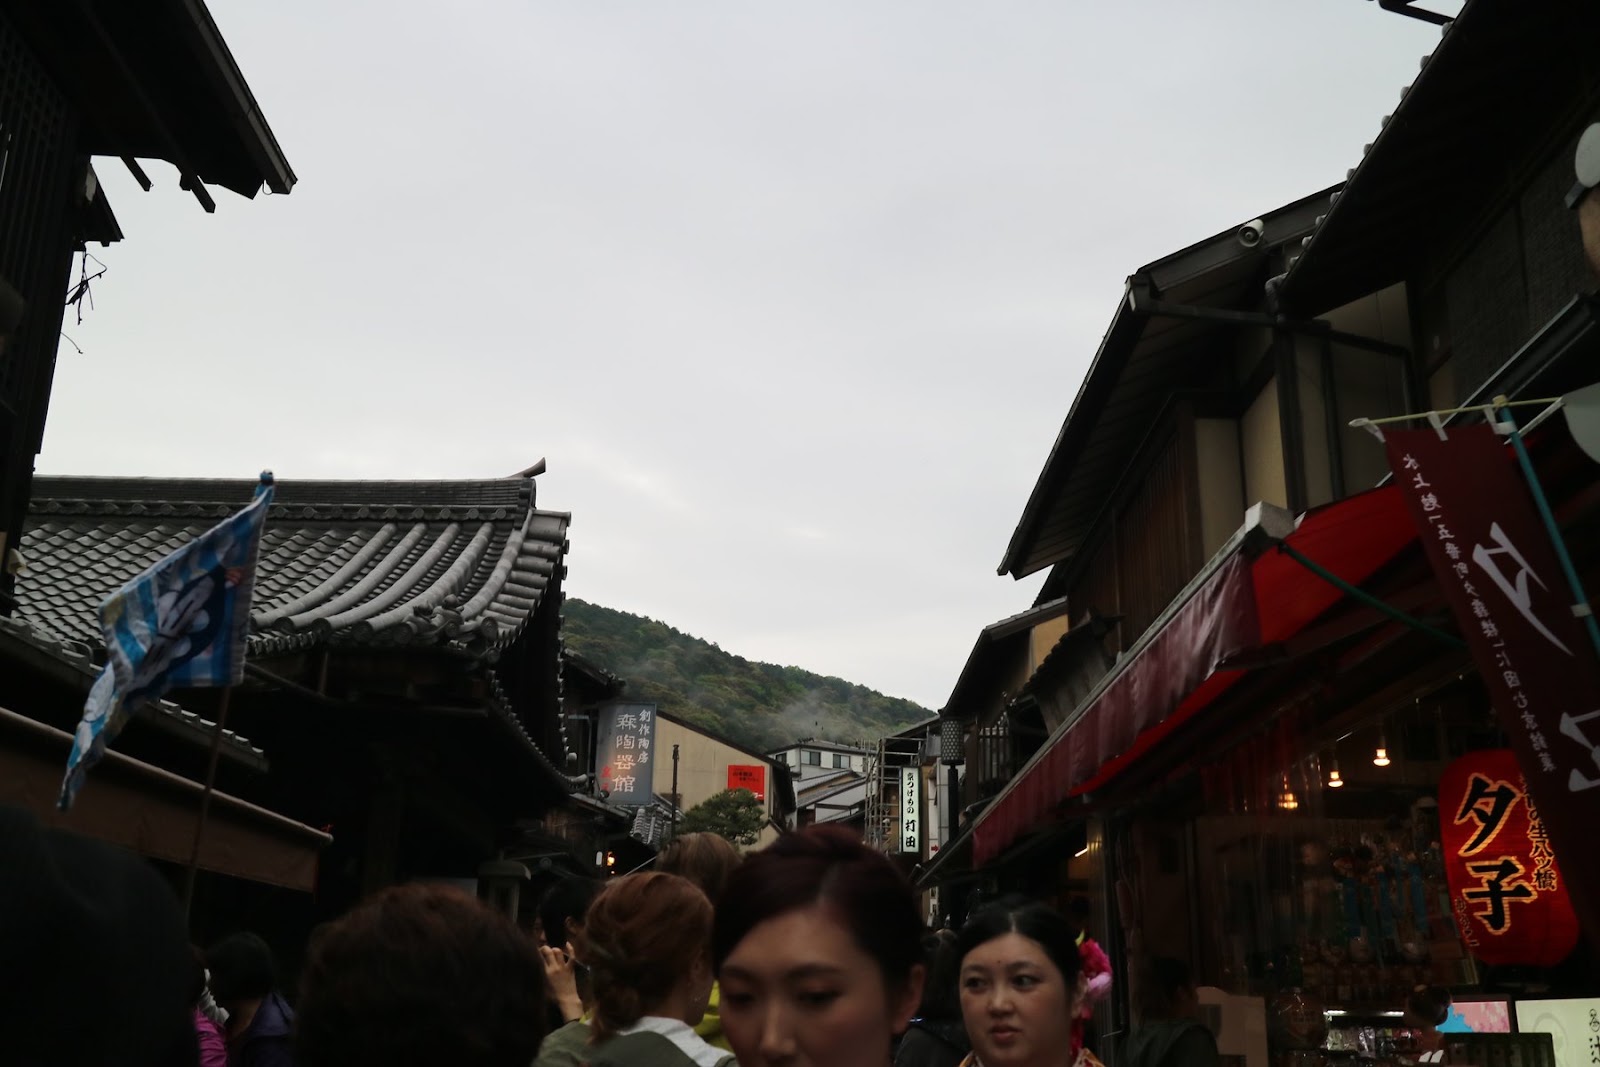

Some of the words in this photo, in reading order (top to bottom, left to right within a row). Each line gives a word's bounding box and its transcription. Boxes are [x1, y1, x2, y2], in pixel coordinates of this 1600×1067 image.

[612, 713, 637, 793] 森陶器館
[637, 708, 652, 764] 創作陶房
[905, 819, 917, 848] 打田
[1453, 772, 1538, 936] 夕子
